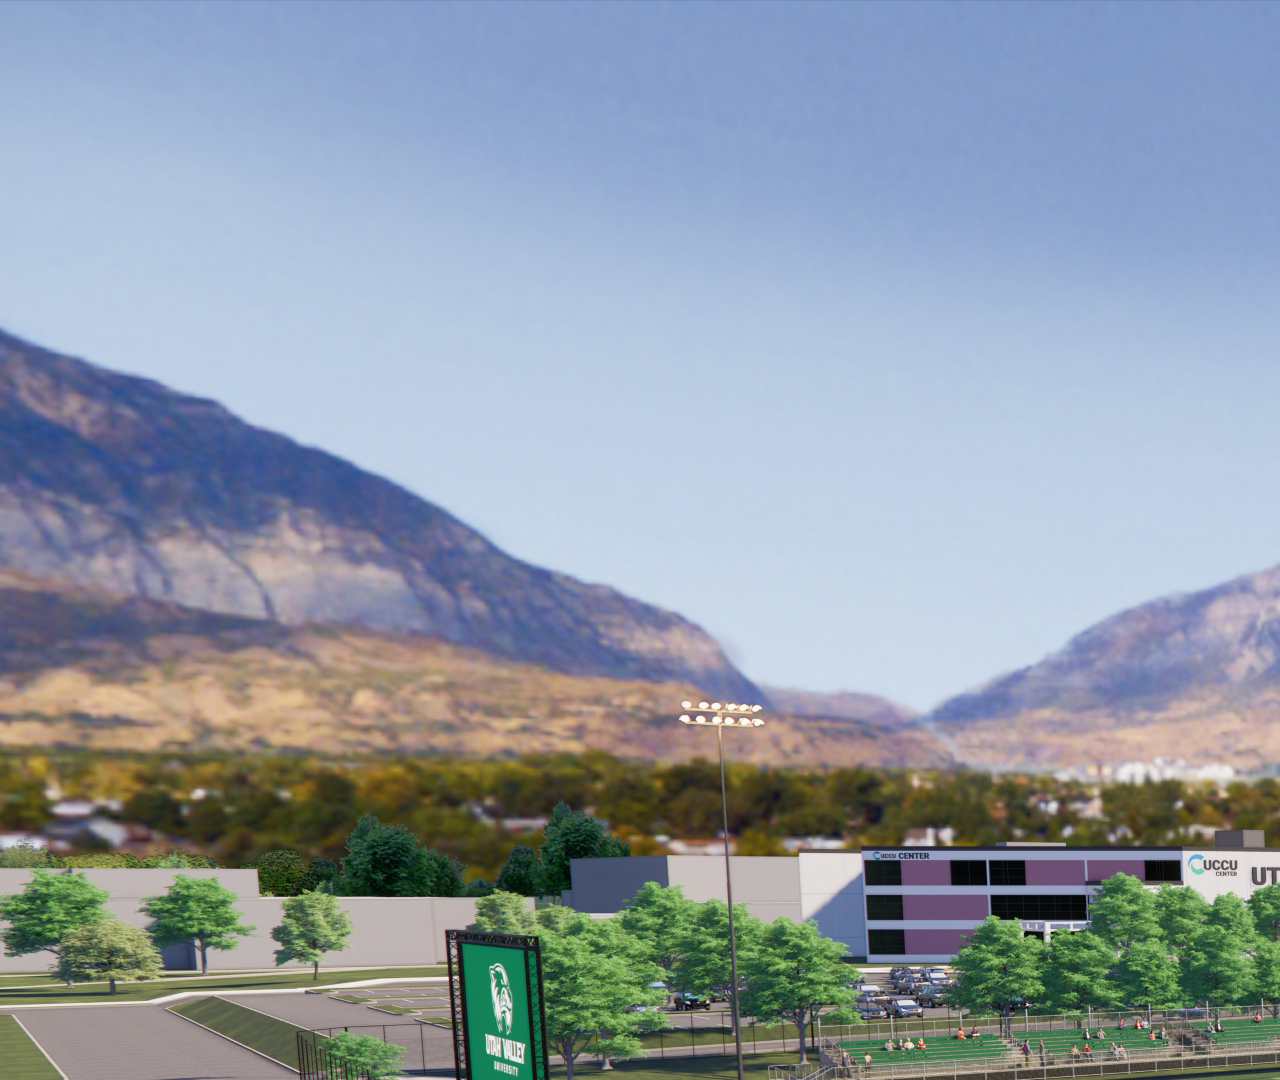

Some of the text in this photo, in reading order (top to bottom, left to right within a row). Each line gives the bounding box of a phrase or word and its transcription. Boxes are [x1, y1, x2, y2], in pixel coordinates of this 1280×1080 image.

[1203, 859, 1238, 871] UCCU
[485, 1033, 526, 1064] UTAH VALLEY
